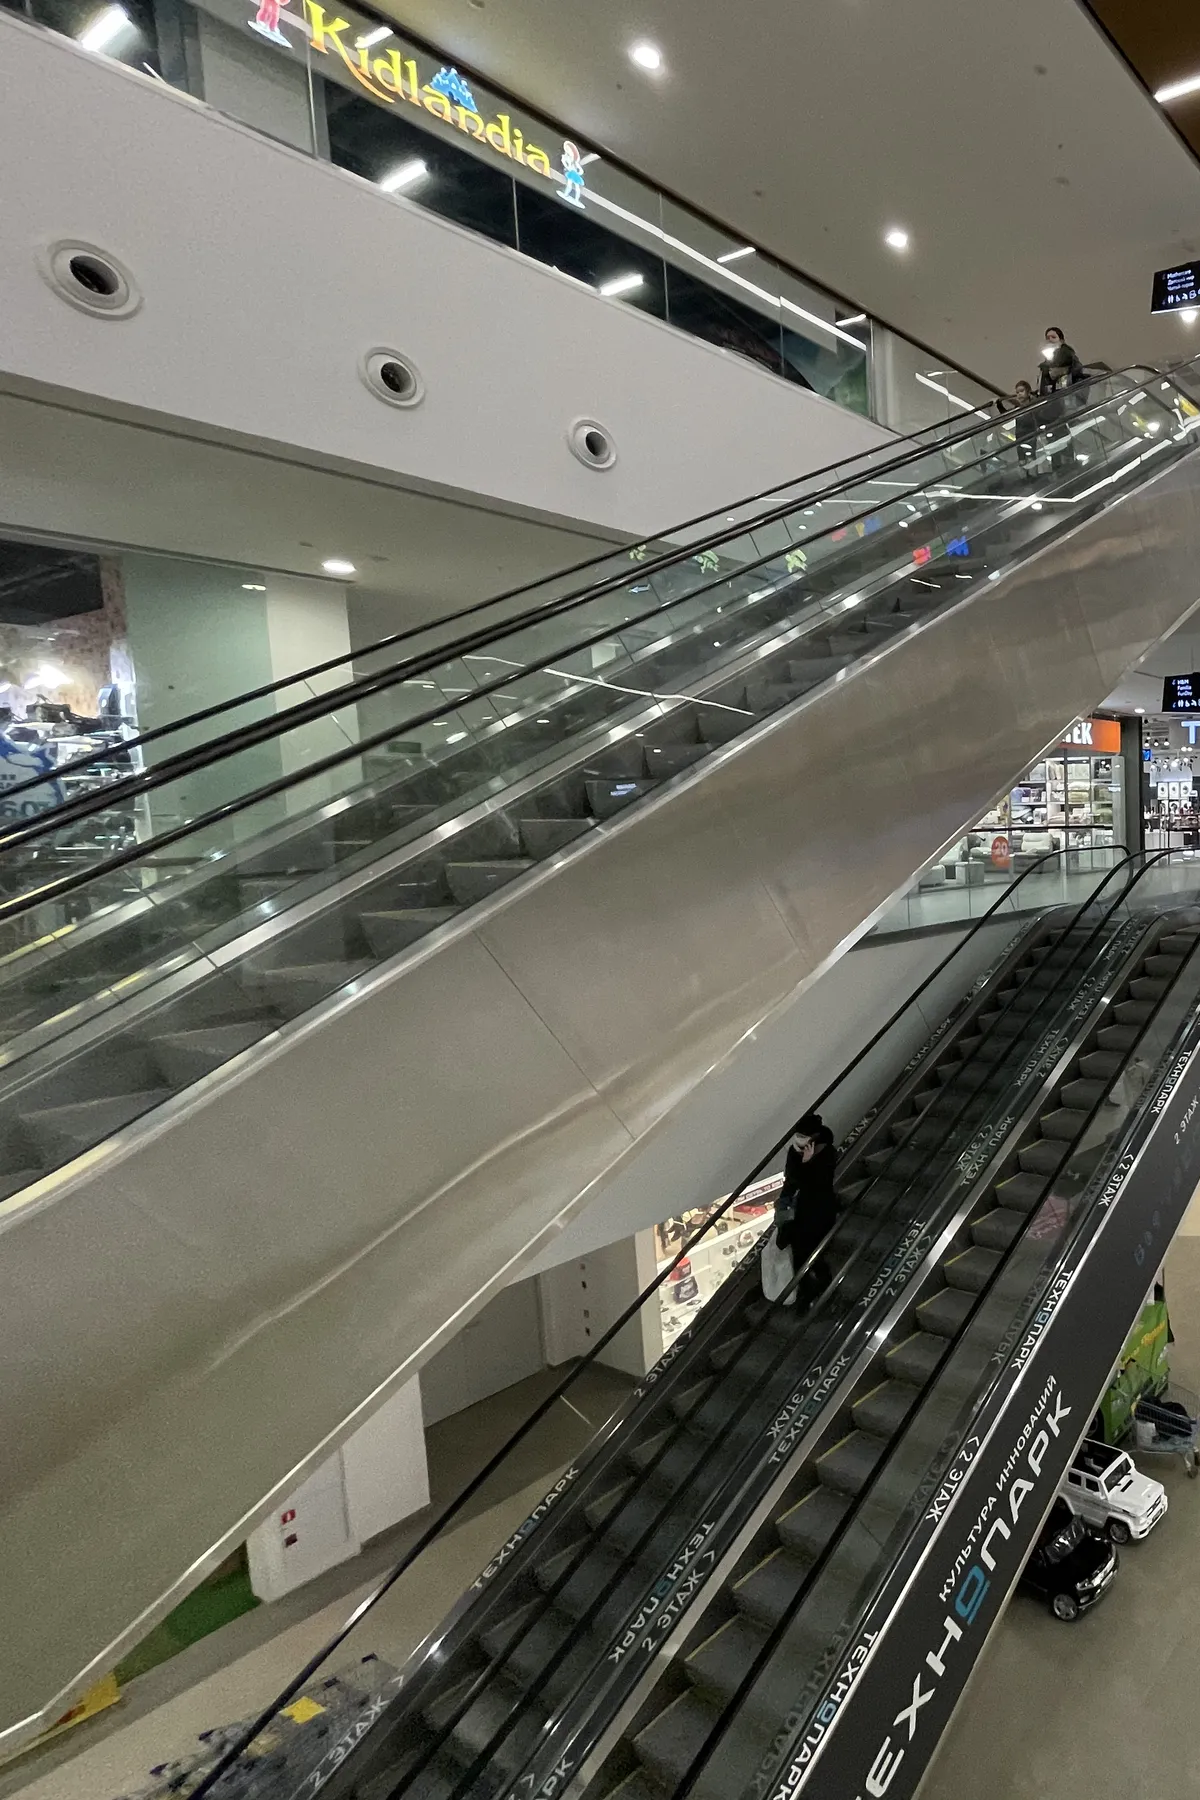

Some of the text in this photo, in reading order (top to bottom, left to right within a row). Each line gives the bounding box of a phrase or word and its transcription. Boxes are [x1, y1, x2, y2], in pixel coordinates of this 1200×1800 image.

[306, 0, 552, 179] Kidlandia
[1075, 970, 1116, 1021] ТЕХНПАРК
[1016, 1028, 1059, 1087] ТЕХНПАРК
[1151, 1050, 1192, 1114] ТЕХНОПАРК
[960, 1115, 1015, 1187] ТЕХНПАРК
[1098, 1162, 1130, 1207] 2 ЭТАЖ
[886, 1247, 926, 1297] 2 ЭТАЖ
[1011, 1270, 1073, 1369] ТЕХНОПАРК
[634, 1343, 685, 1399] 2 ЭТАЖ
[766, 1378, 815, 1439] 2 ЭТАЖ
[925, 1449, 974, 1523] 2 ЭТАЖ
[939, 1374, 1057, 1603] КУЛЬТУРА ИННОВАЦИЙ
[471, 1466, 579, 1590] ТЕХНОПАРК
[608, 1520, 715, 1663] ТЕХНОПАРК
[641, 1571, 705, 1652] 2 ЭТАЖ
[855, 1390, 1072, 1800] ЕХНОПАРК
[773, 1631, 878, 1800] ТЕХНОПАРК
